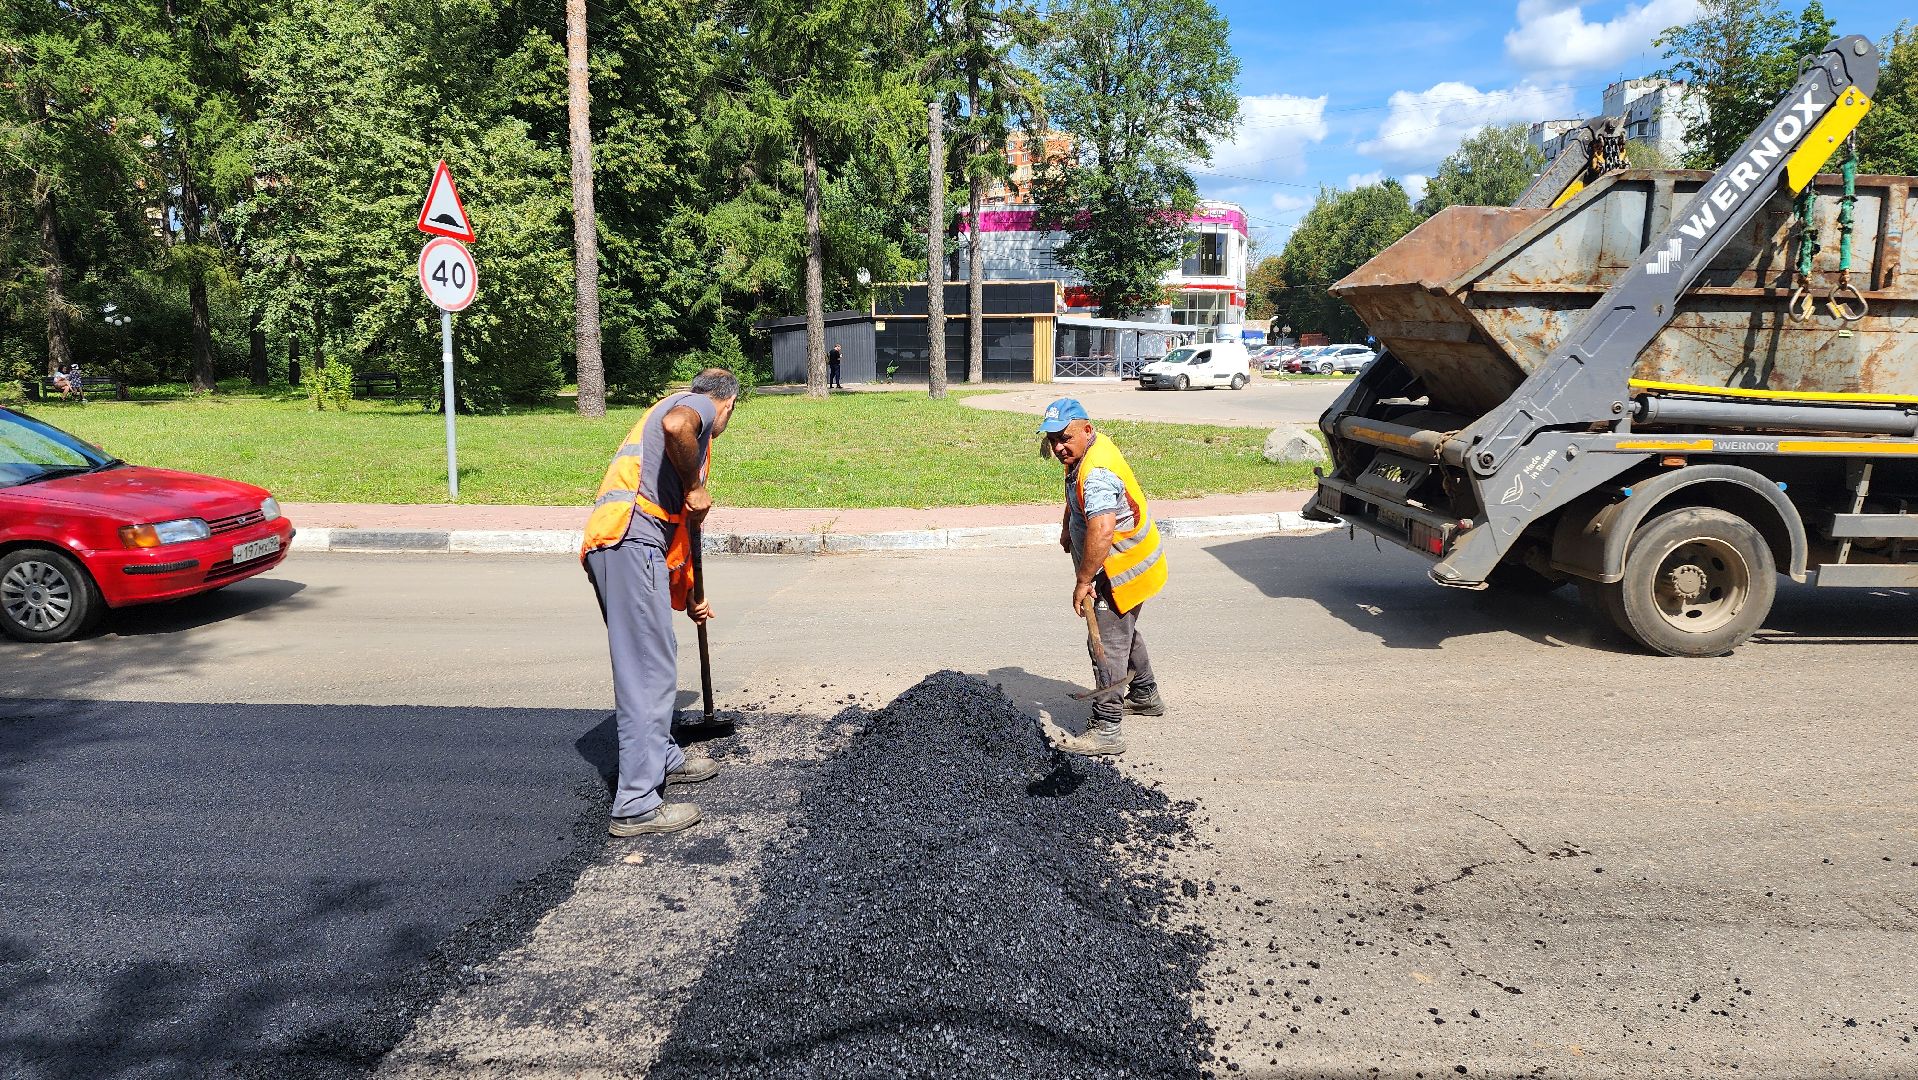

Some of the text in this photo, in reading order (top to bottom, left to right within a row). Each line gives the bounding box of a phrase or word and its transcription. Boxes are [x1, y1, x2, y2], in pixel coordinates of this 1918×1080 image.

[1679, 90, 1827, 240] WERNOX
[432, 260, 466, 289] 40
[1717, 441, 1774, 451] WERNOX
[1523, 455, 1541, 475] Made
[1529, 471, 1540, 480] in
